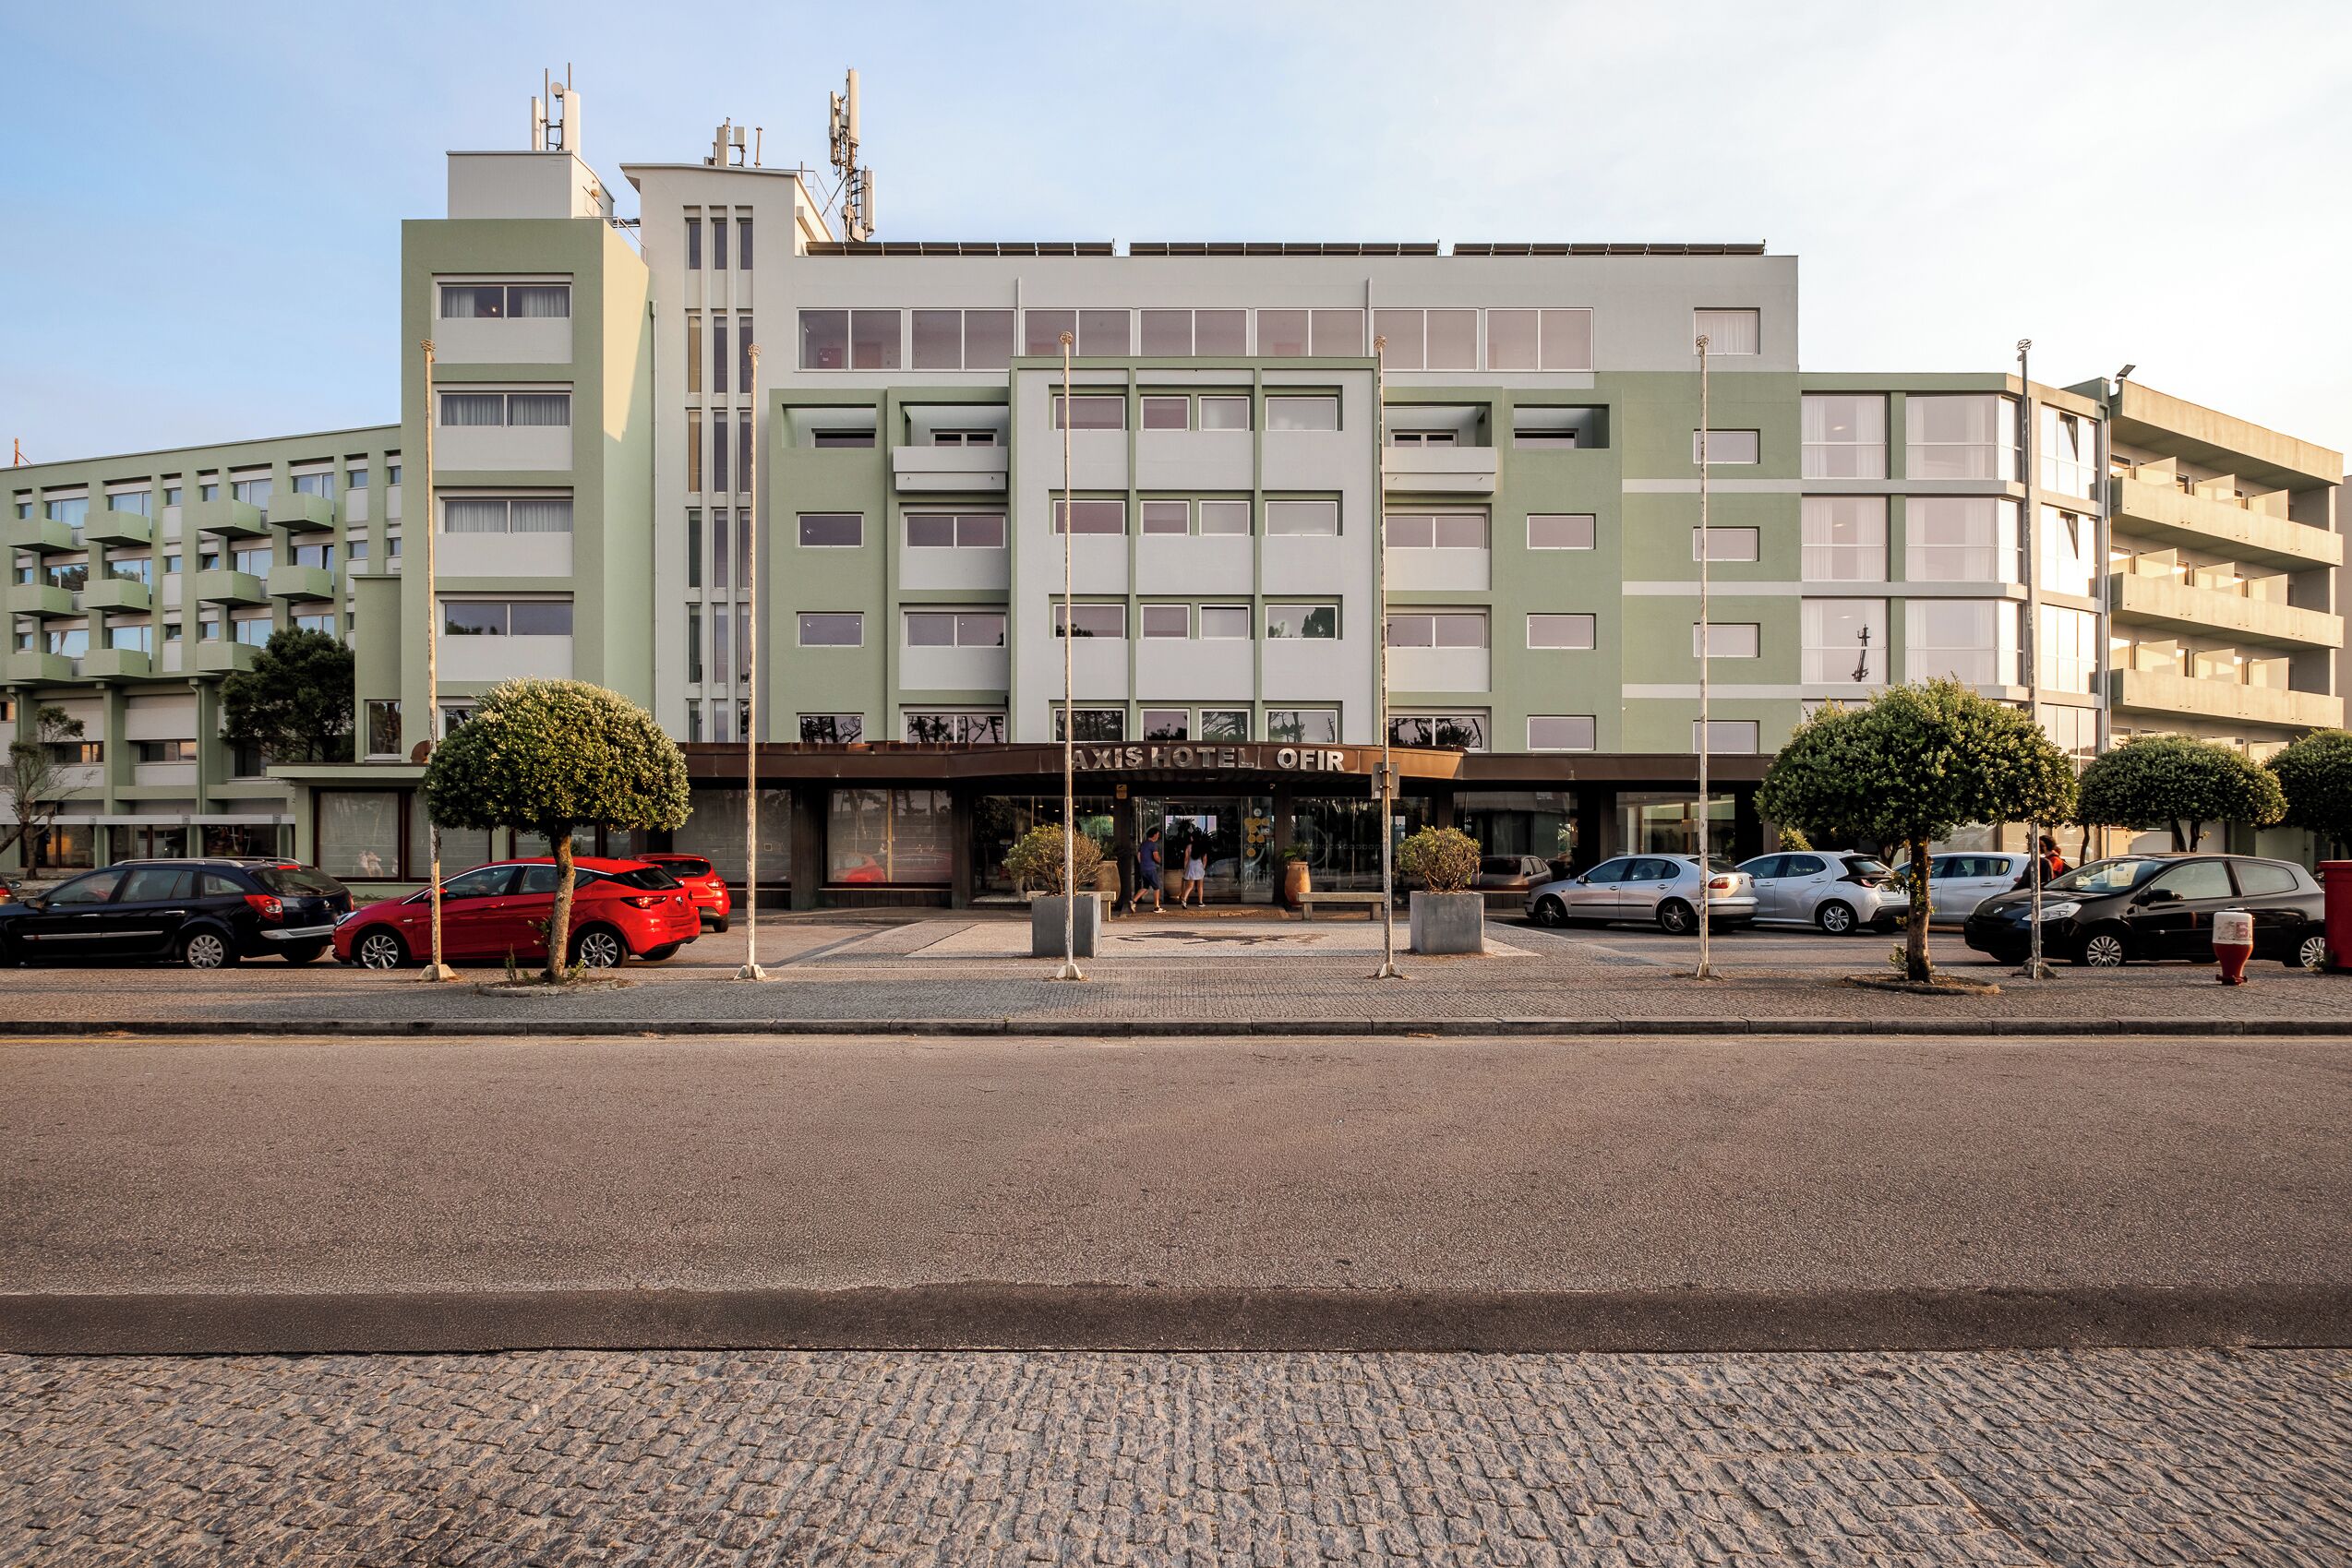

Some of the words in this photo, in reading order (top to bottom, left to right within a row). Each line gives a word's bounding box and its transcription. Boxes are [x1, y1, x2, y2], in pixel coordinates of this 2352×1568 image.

[1071, 747, 1144, 770] AXIS
[1151, 747, 1254, 768] HOTEL
[1277, 748, 1345, 772] OFIR
